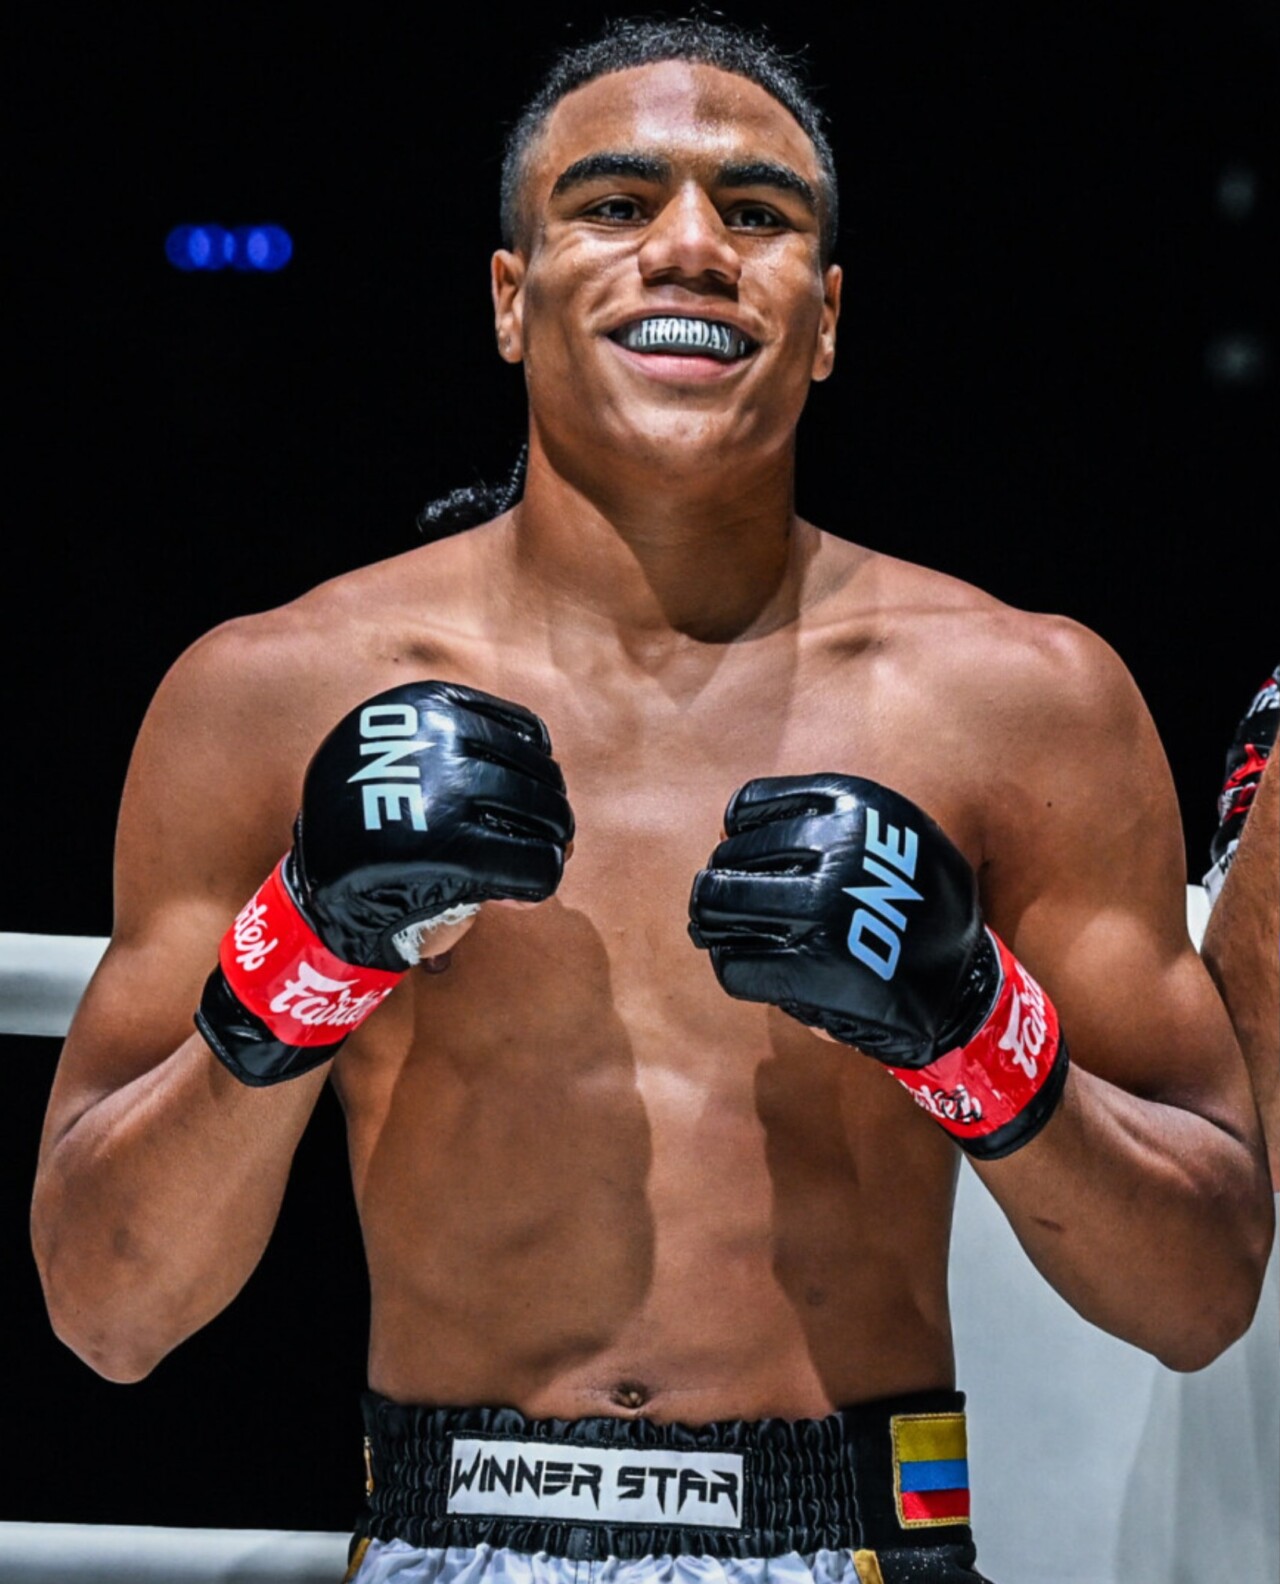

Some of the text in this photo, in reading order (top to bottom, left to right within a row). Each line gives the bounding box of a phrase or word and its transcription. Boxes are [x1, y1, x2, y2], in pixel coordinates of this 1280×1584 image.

[346, 703, 437, 832] ONE
[842, 807, 924, 981] ONE
[450, 1447, 739, 1519] WINNER STAR
